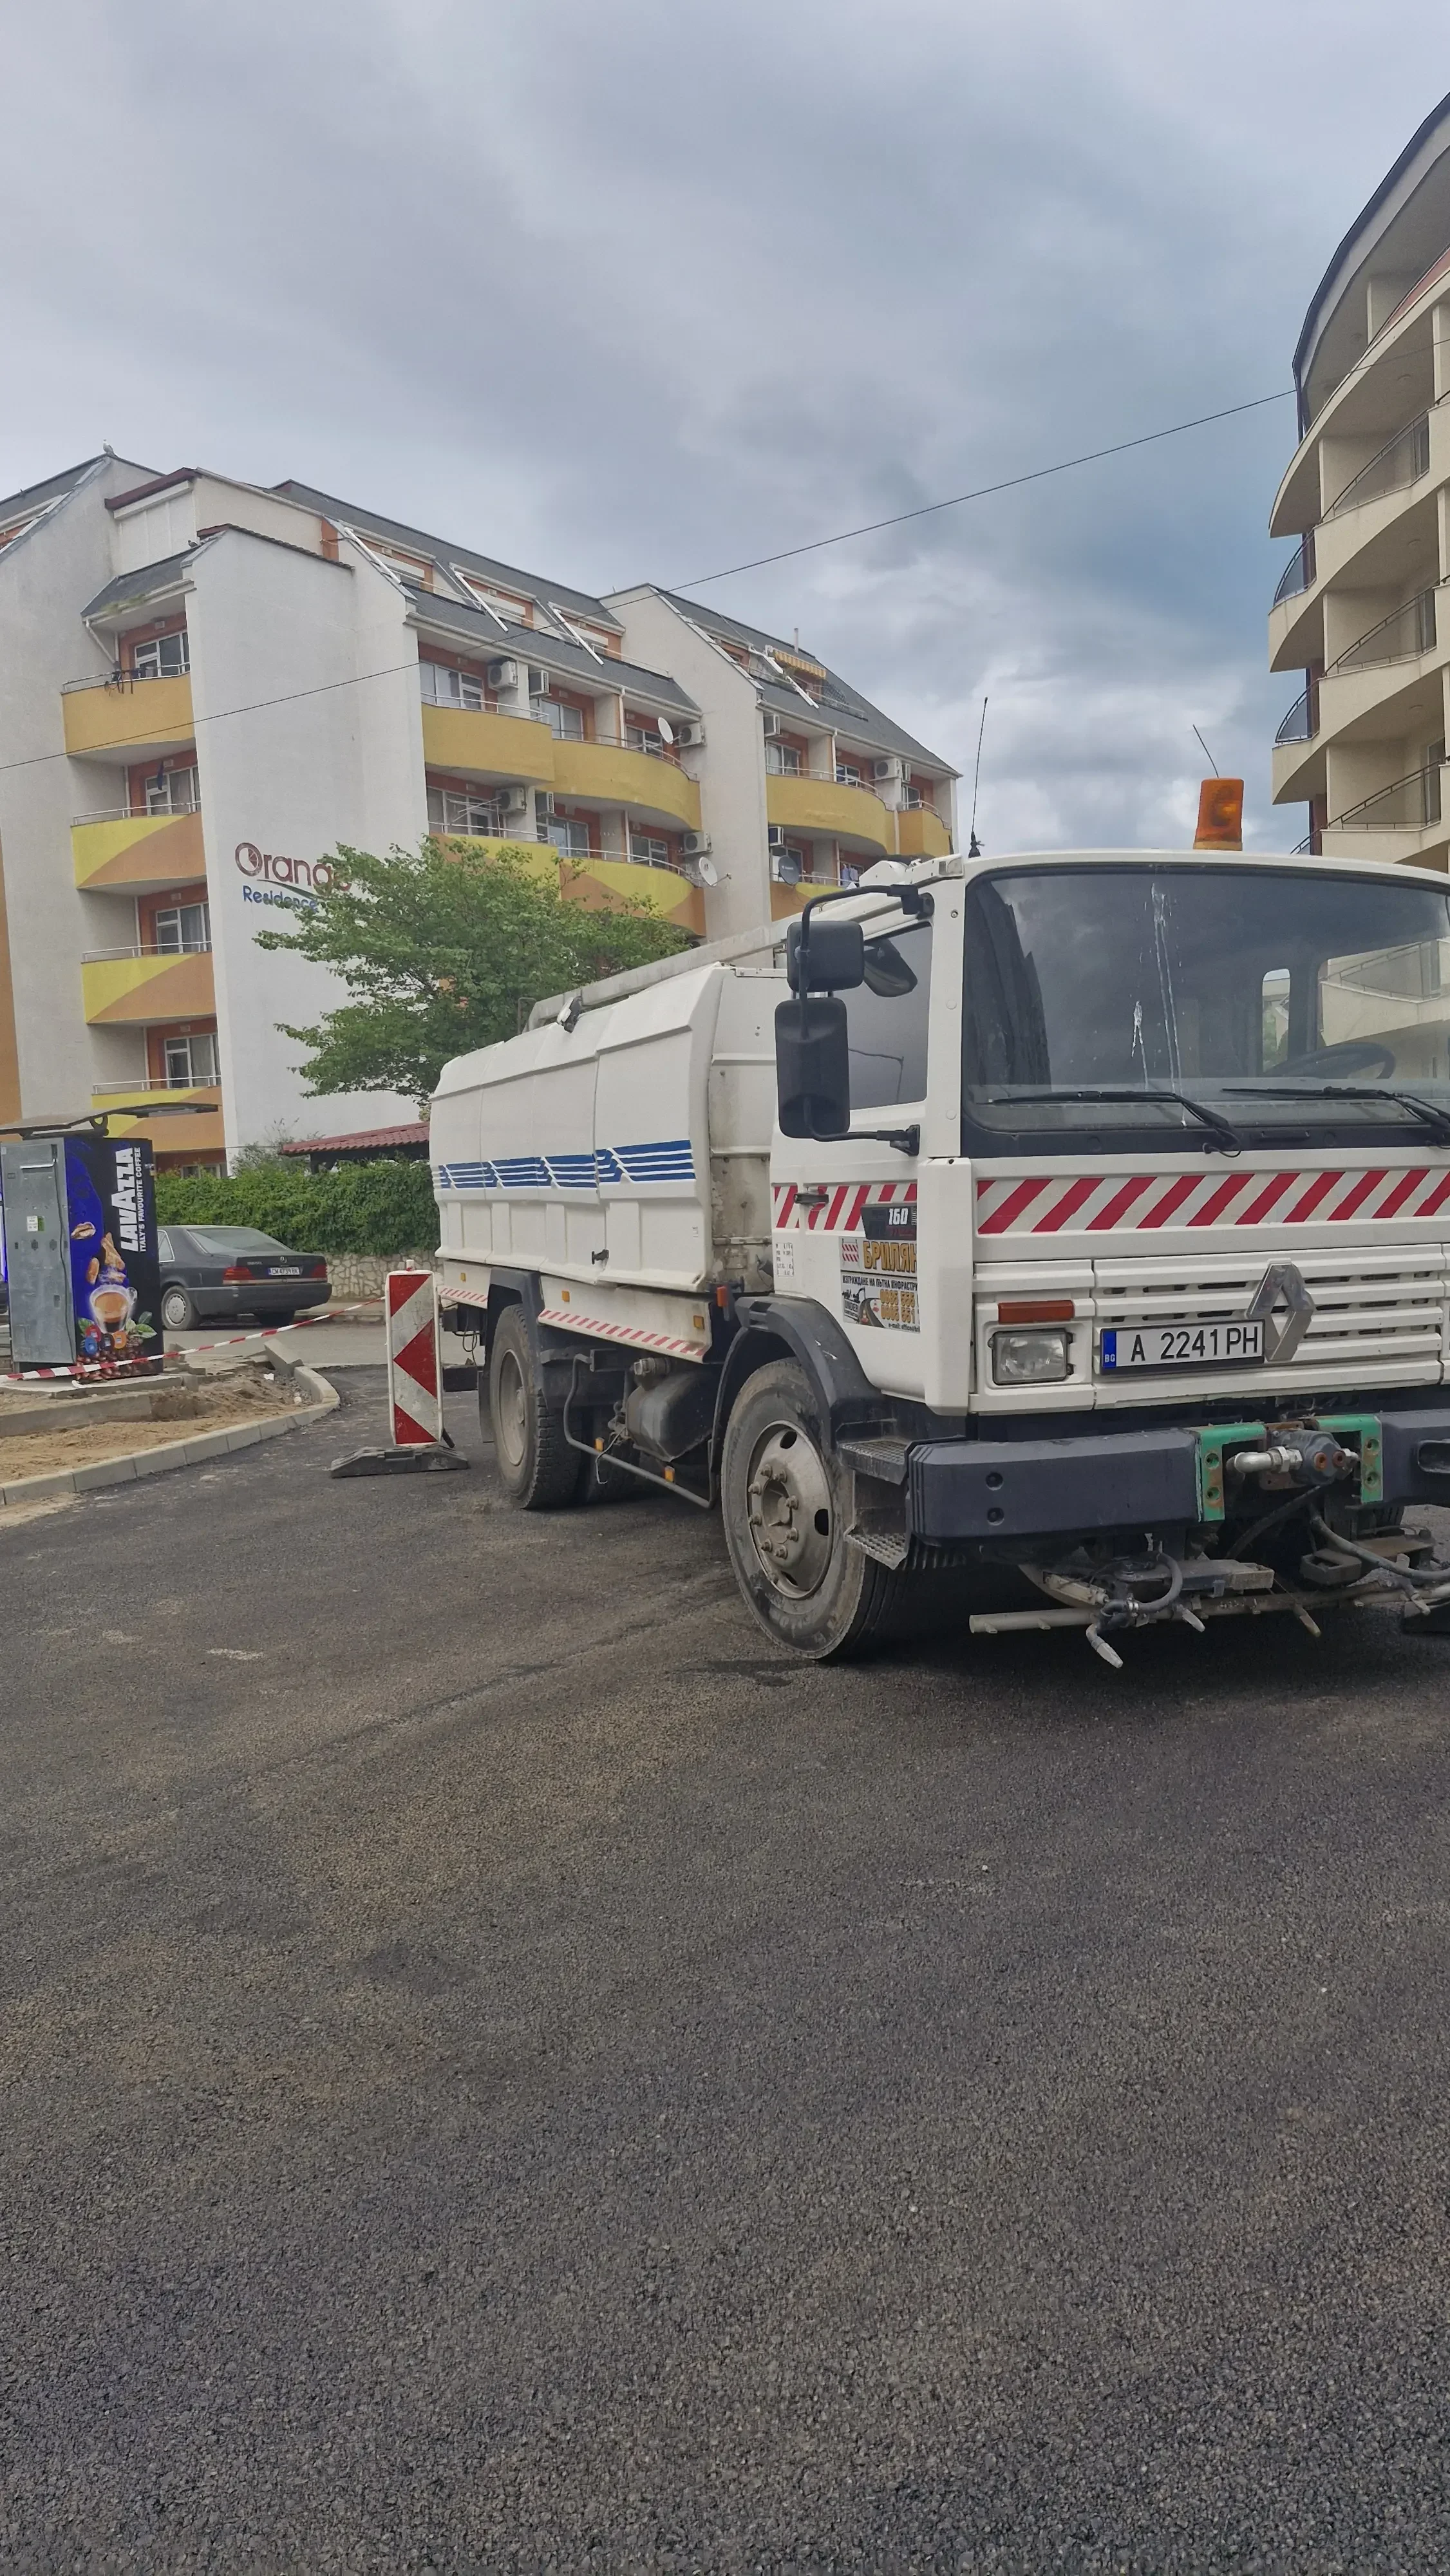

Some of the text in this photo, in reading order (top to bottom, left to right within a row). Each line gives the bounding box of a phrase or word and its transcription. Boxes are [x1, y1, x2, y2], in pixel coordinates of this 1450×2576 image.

[111, 1147, 140, 1252] LAVAZZA
[134, 1147, 147, 1252] ITALY'S FAVOURITE COFFEE
[889, 1208, 909, 1225] 160
[869, 1278, 875, 1287] НА
[876, 1278, 890, 1288] ПЪТНА
[1131, 1334, 1145, 1362] A
[1160, 1328, 1218, 1361] 2241
[1104, 1354, 1116, 1363] BG
